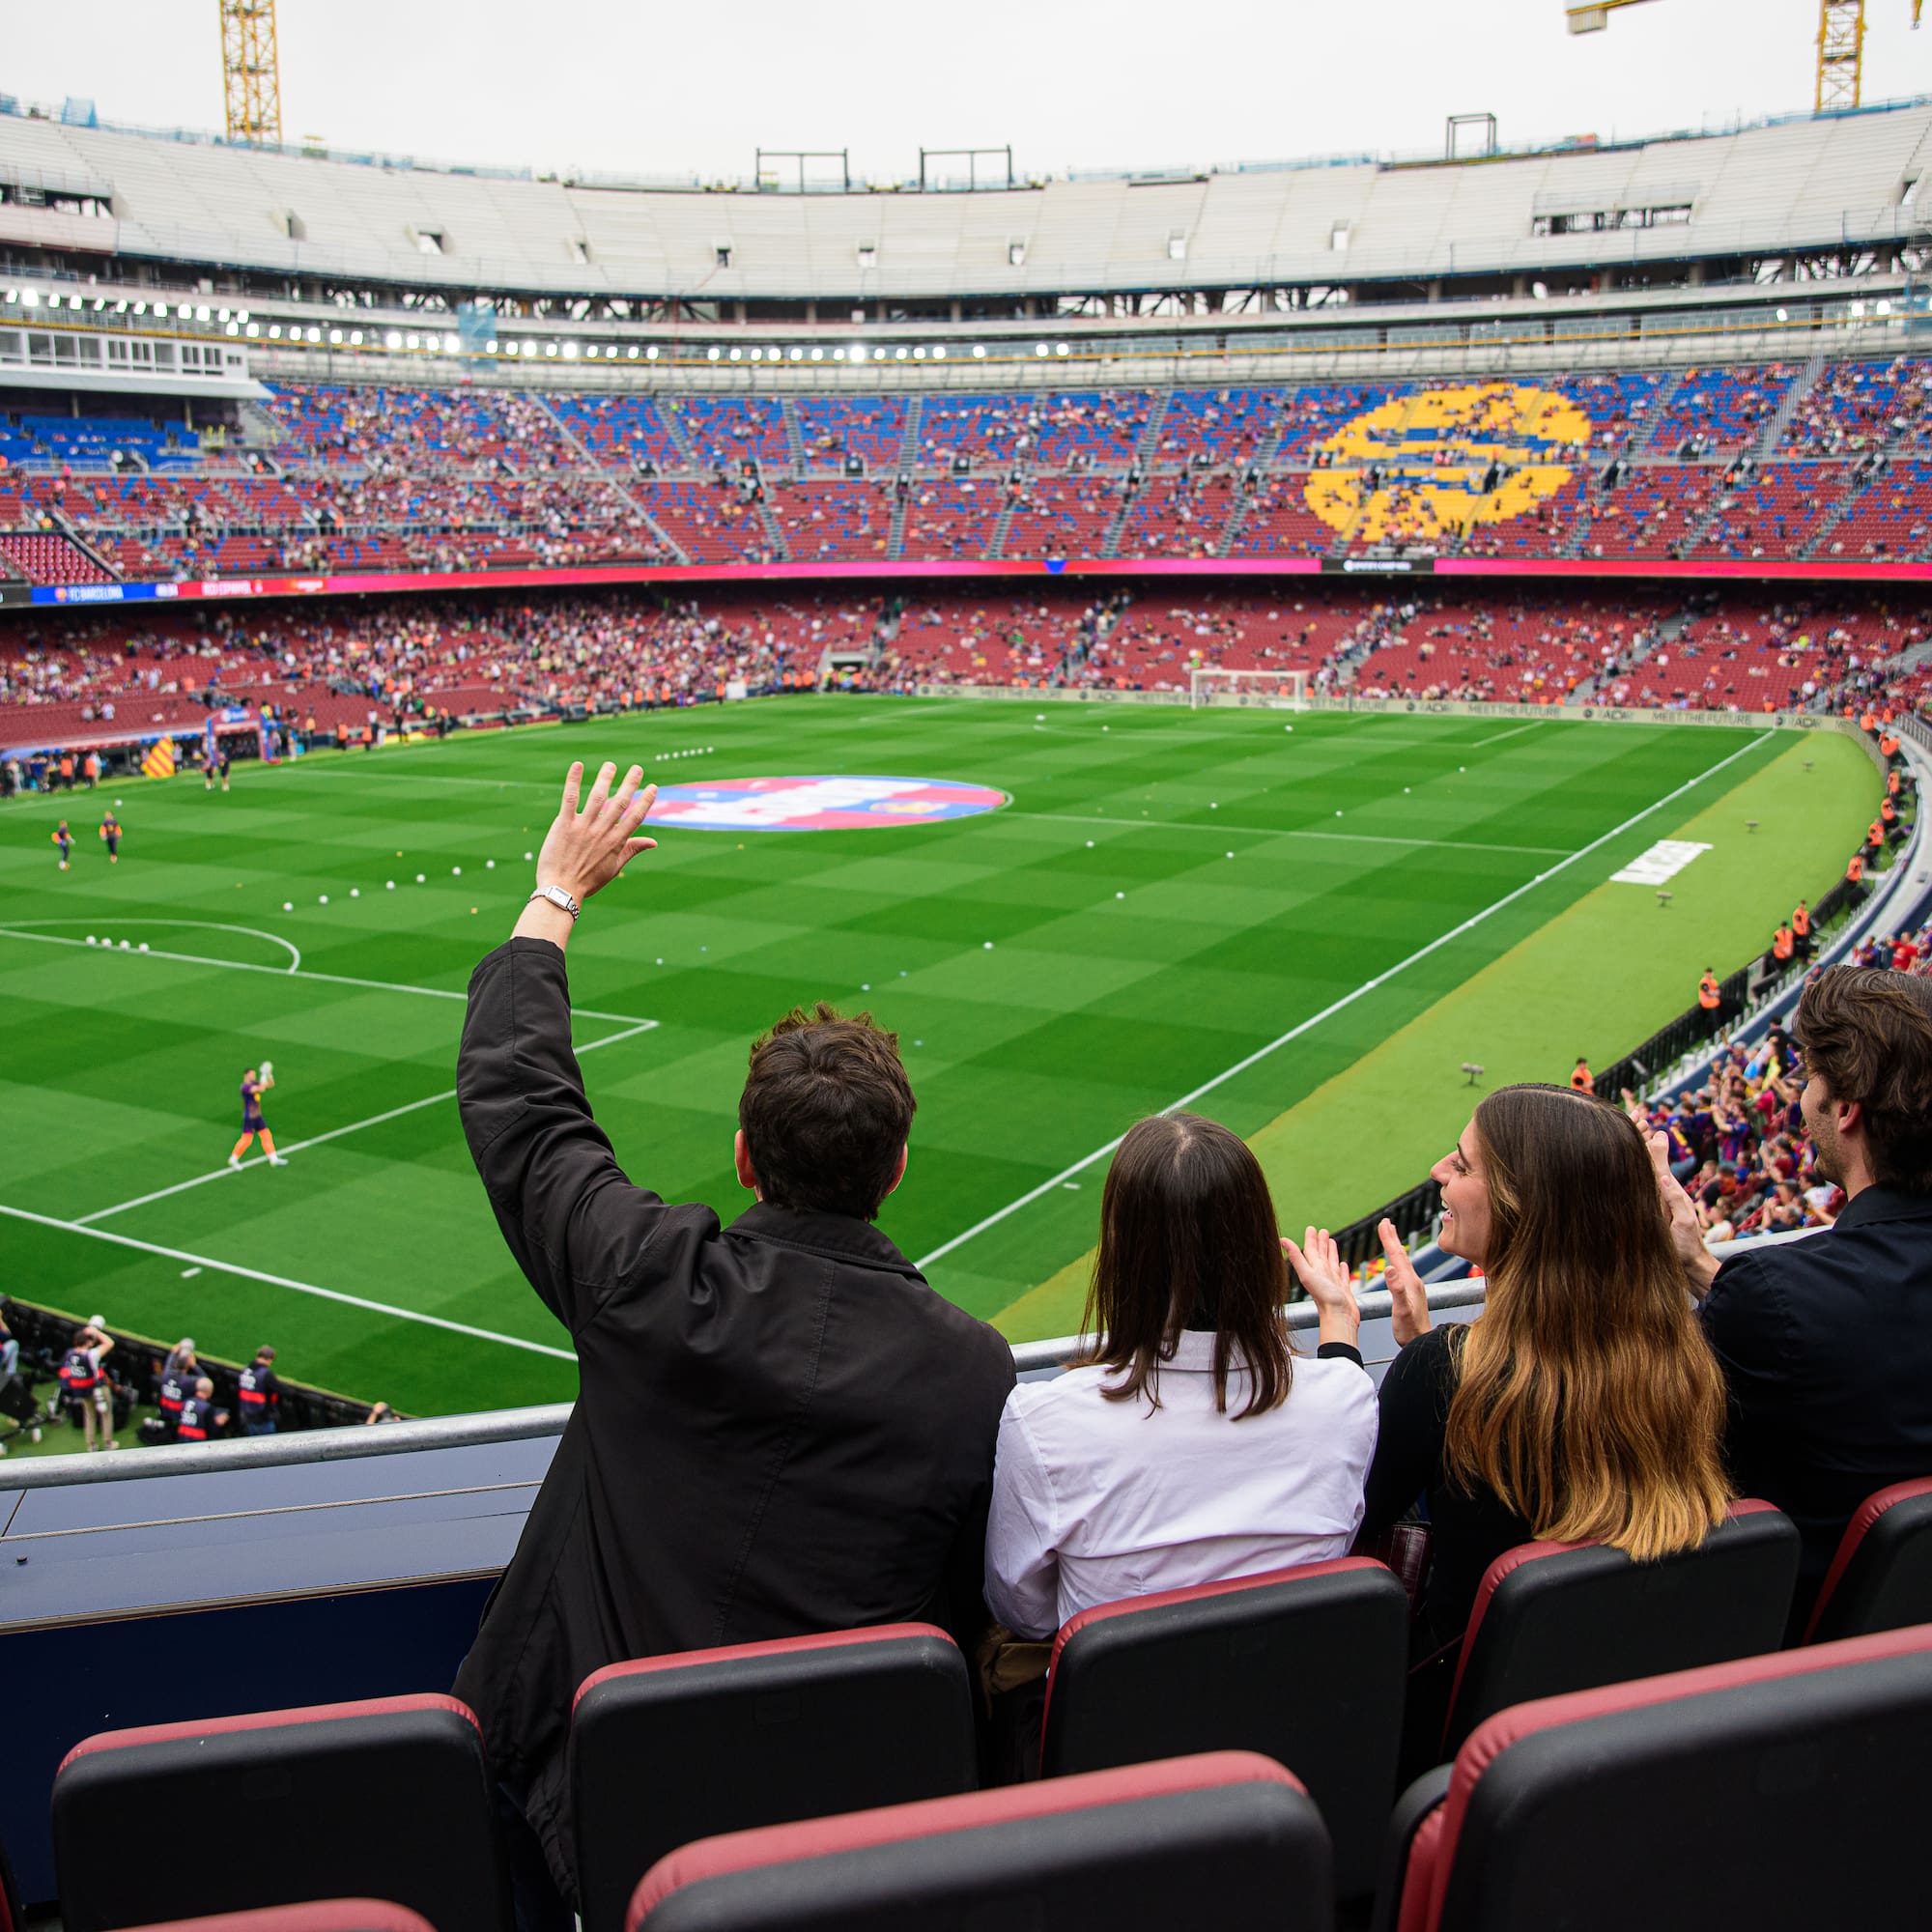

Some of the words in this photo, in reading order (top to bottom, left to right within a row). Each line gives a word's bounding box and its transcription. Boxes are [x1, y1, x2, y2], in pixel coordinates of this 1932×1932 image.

[80, 584, 124, 602] BARCELONA
[1653, 711, 1683, 724] MEET
[1684, 712, 1705, 725] THE
[1706, 713, 1752, 728] FUTURE
